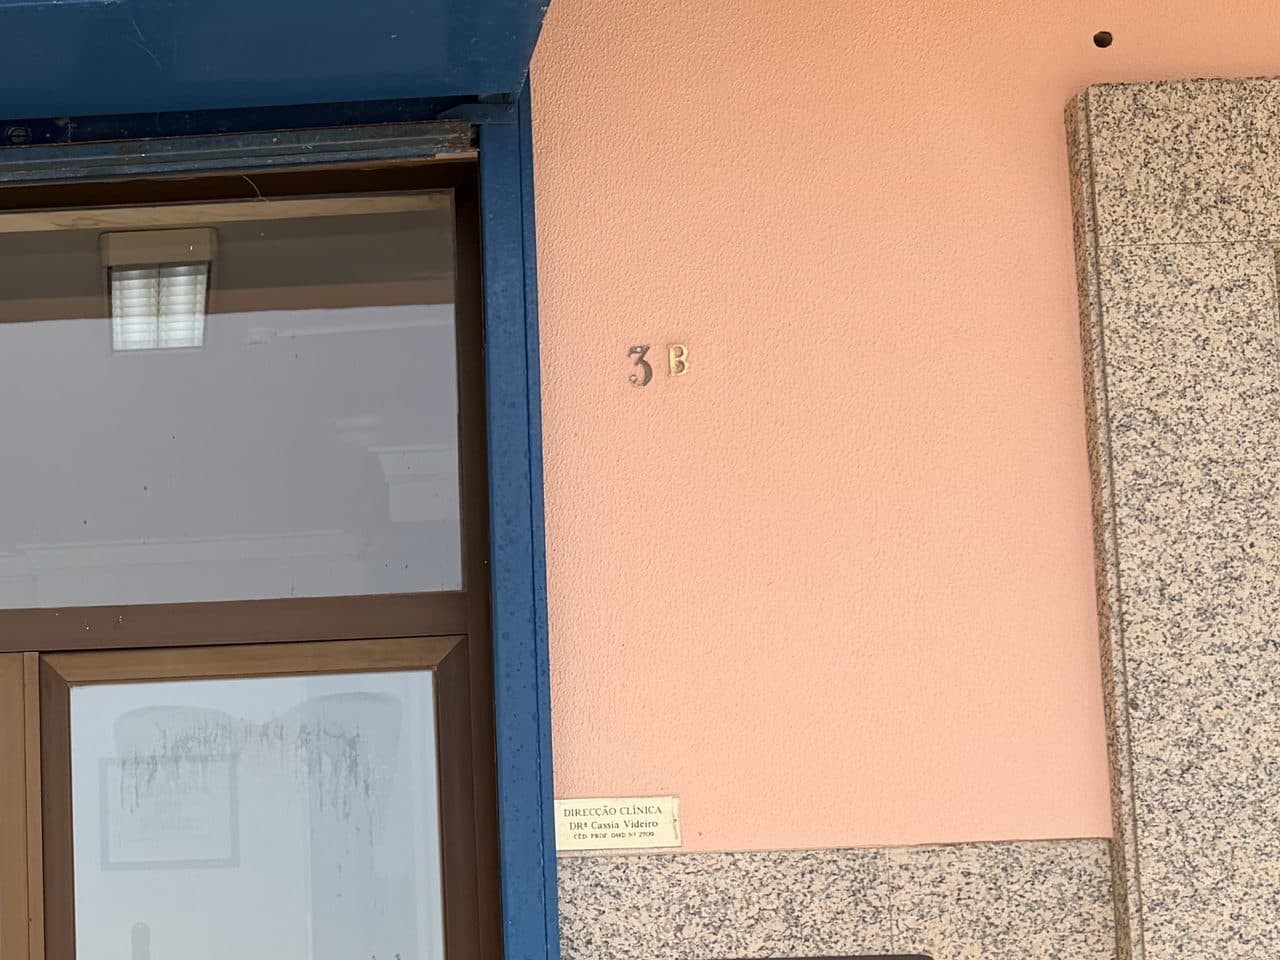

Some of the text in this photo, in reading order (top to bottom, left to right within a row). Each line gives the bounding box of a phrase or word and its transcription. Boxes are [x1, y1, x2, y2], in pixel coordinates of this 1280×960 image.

[626, 343, 689, 388] 3 B
[563, 804, 663, 817] DIRECÇÃO CLÍNICA
[591, 821, 620, 830] Cassia
[623, 819, 659, 829] Videiro
